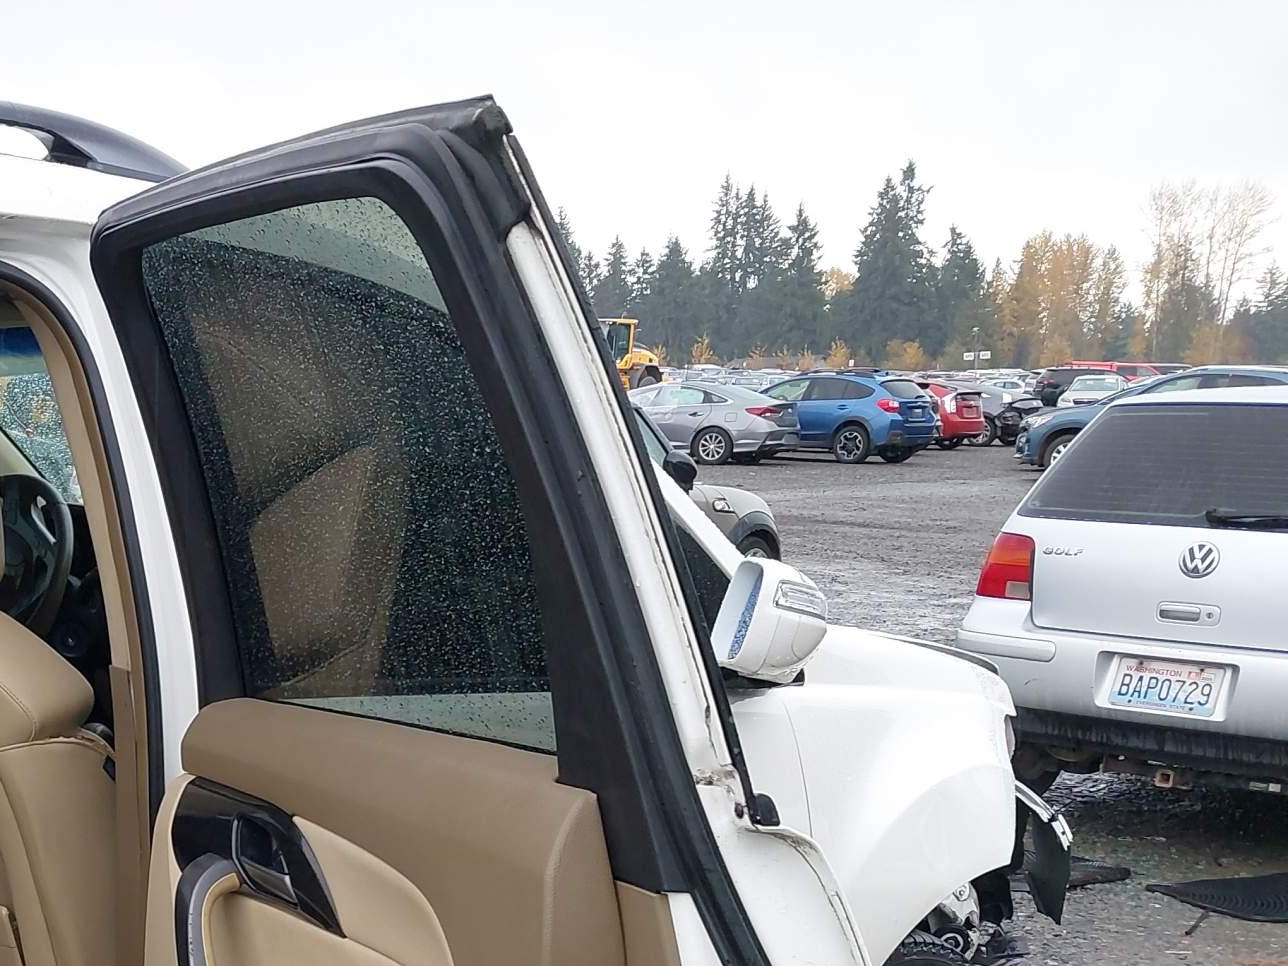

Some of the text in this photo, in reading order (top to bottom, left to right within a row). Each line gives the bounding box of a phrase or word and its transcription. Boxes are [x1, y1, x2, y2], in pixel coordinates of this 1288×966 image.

[1042, 545, 1084, 557] GOLF
[1126, 664, 1183, 678] WASHINGTON
[1117, 673, 1213, 706] BAP0729
